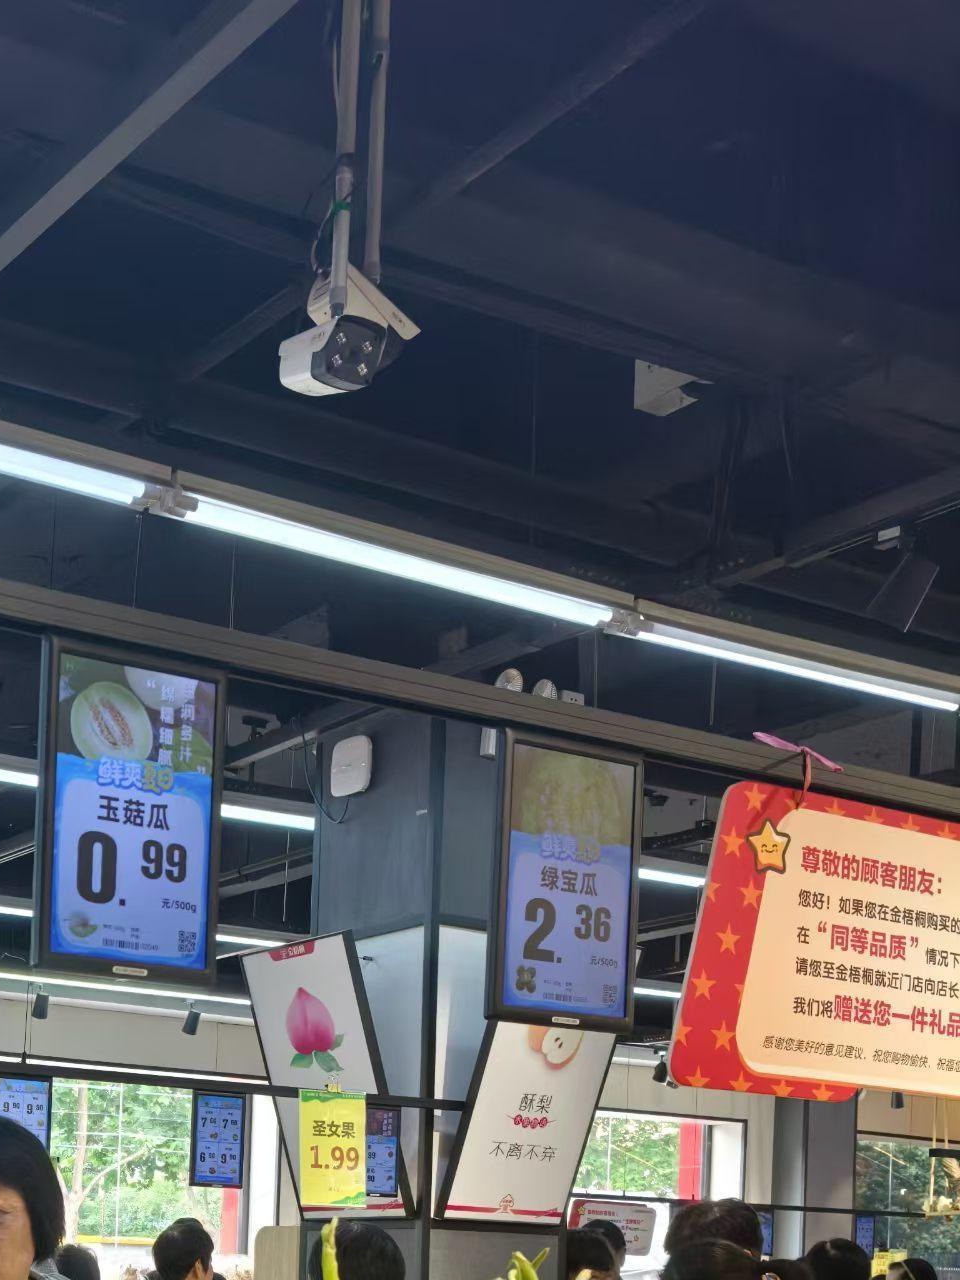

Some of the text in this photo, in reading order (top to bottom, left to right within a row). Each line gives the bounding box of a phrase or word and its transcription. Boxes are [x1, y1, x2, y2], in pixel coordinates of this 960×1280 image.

[97, 794, 170, 832] 玉菇瓜
[540, 865, 598, 897] 绿宝瓜
[801, 845, 942, 897] 尊敬的顾客朋友：
[161, 898, 198, 914] 元/500g
[522, 897, 612, 964] 2.36
[519, 1093, 553, 1114] 酥梨
[312, 1120, 356, 1139] 圣女果
[310, 1145, 360, 1171] 1.99
[489, 1140, 559, 1162] 不离不弃
